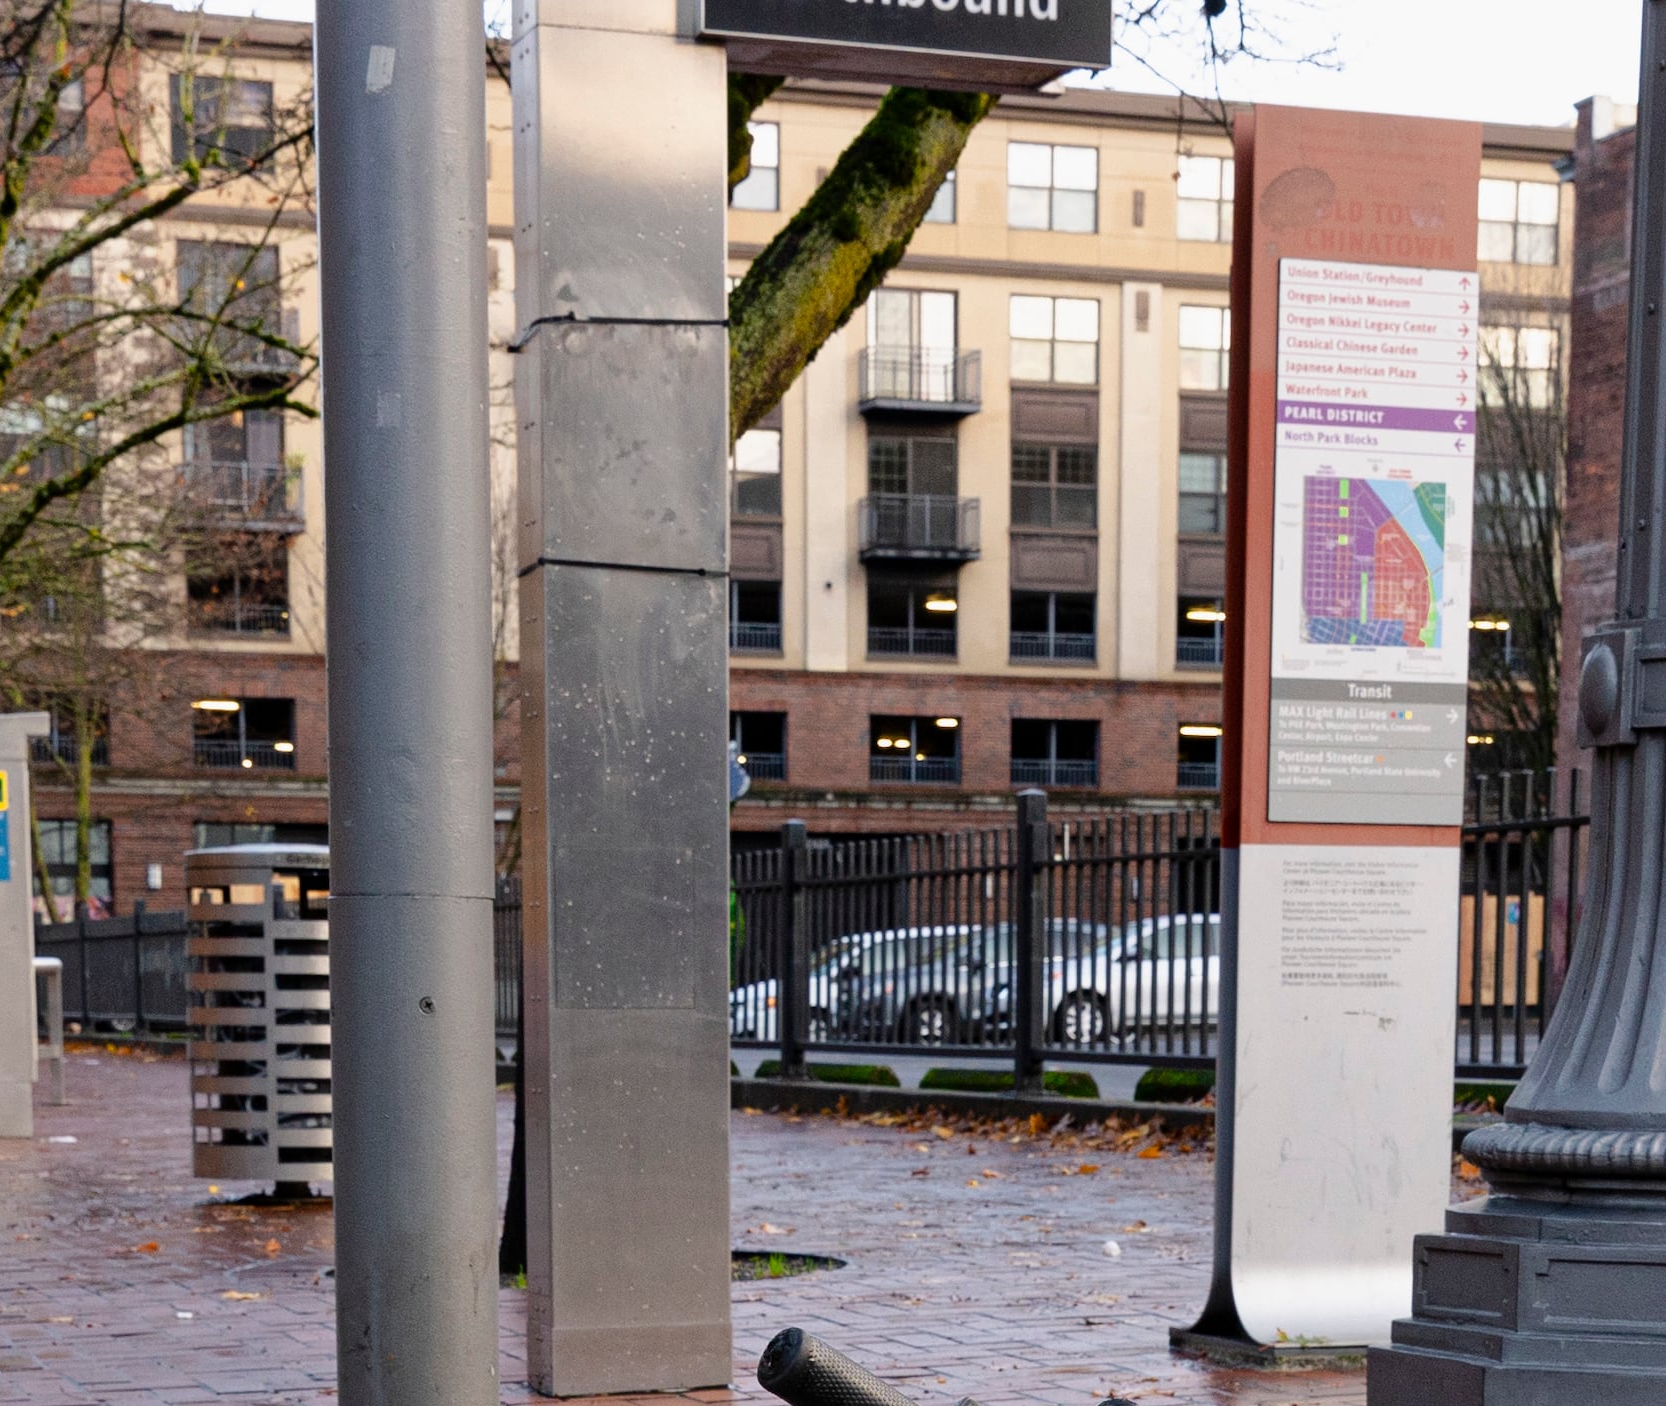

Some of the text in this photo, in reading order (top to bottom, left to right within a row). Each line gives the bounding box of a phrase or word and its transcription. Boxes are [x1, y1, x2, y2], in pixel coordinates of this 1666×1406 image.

[1288, 267, 1423, 287] Union Station/Greyhound
[1287, 290, 1411, 309] Oregon Jewish Museum
[1287, 313, 1325, 327] Oregon
[1364, 318, 1400, 333] Legacy
[1403, 321, 1437, 333] Center
[1286, 337, 1418, 355] Classical Chinese Garden
[1285, 360, 1417, 379] Japanese American Plaza
[1285, 383, 1368, 399] Waterfront Park
[1284, 405, 1385, 423] PEARL DISTRICT
[1285, 430, 1378, 446] North Park Blocks
[1347, 683, 1393, 699] Transit
[1278, 705, 1387, 720] MAX Light Rail Lines
[1277, 751, 1374, 765] Portland Streetcar
